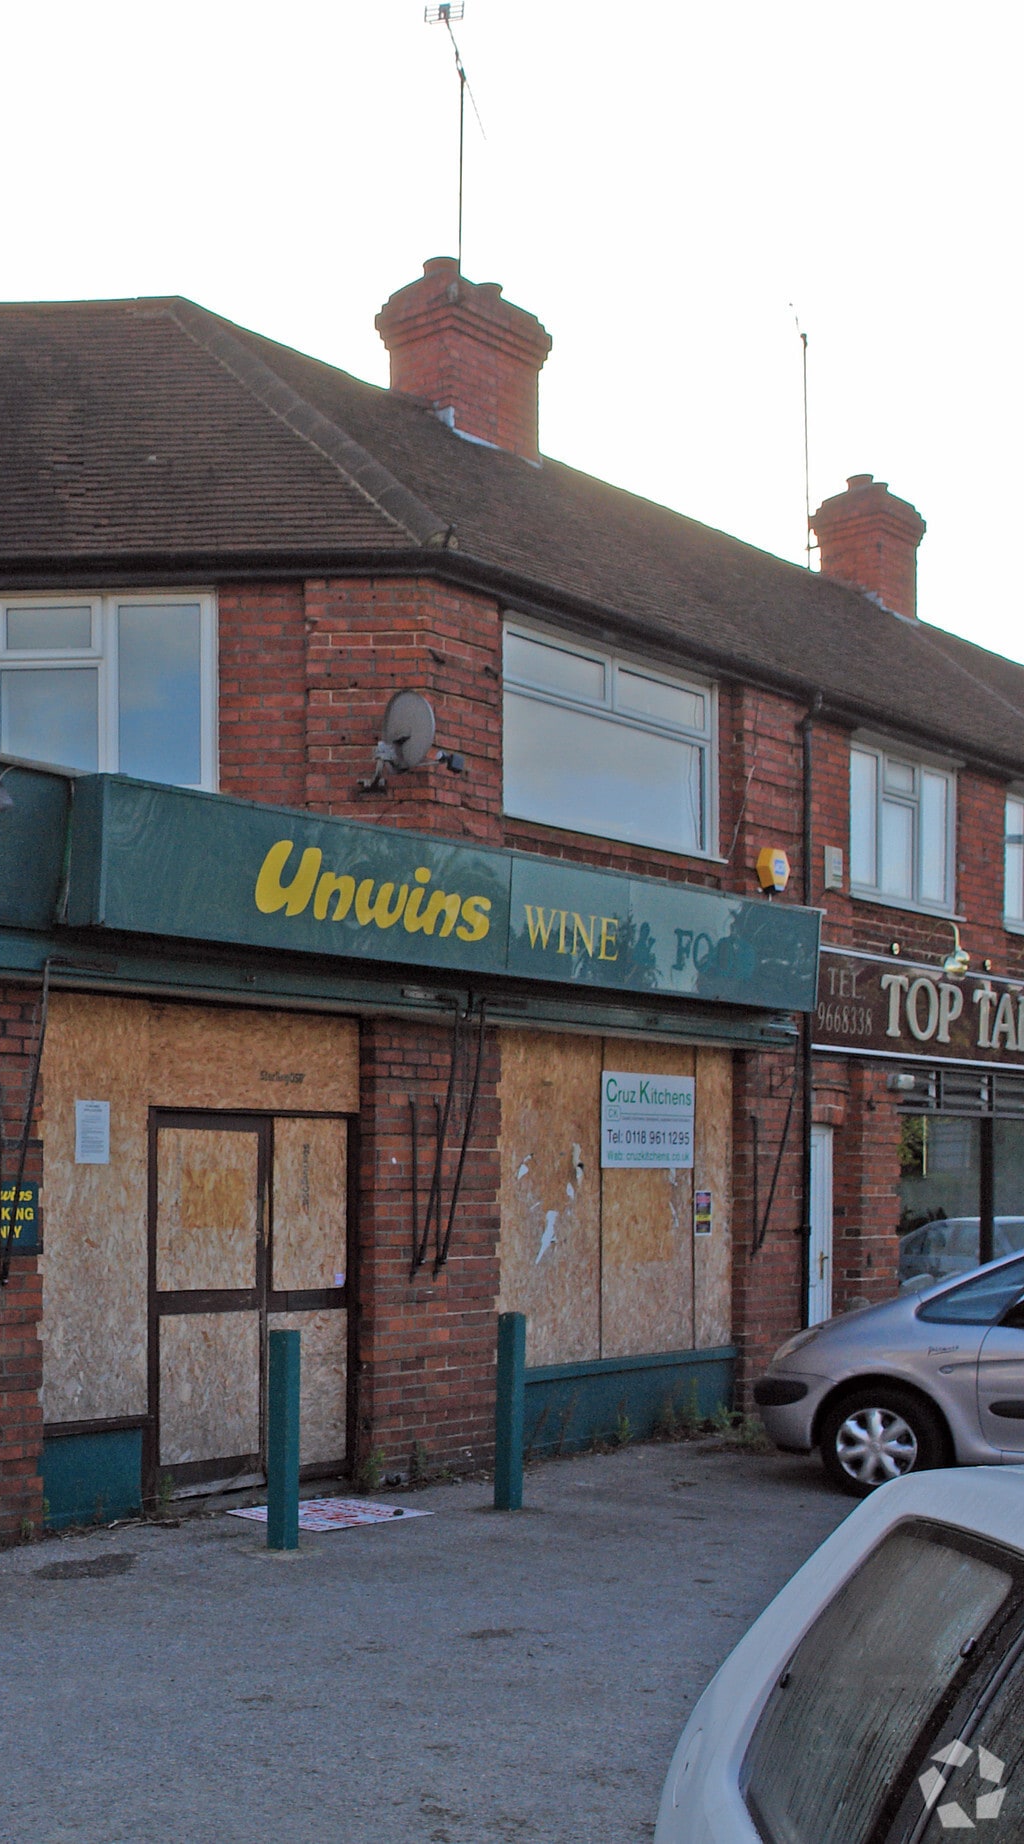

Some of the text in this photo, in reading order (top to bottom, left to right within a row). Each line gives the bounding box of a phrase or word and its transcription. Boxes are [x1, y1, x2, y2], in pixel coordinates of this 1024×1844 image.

[254, 839, 492, 942] Unwins
[523, 904, 619, 961] WINE
[817, 1001, 873, 1036] 9668338
[880, 973, 964, 1043] TOP
[606, 1078, 692, 1106] Cruz Kitchens
[607, 1129, 623, 1144] Tel:
[625, 1130, 647, 1145] 0118
[668, 1131, 690, 1146] 1295
